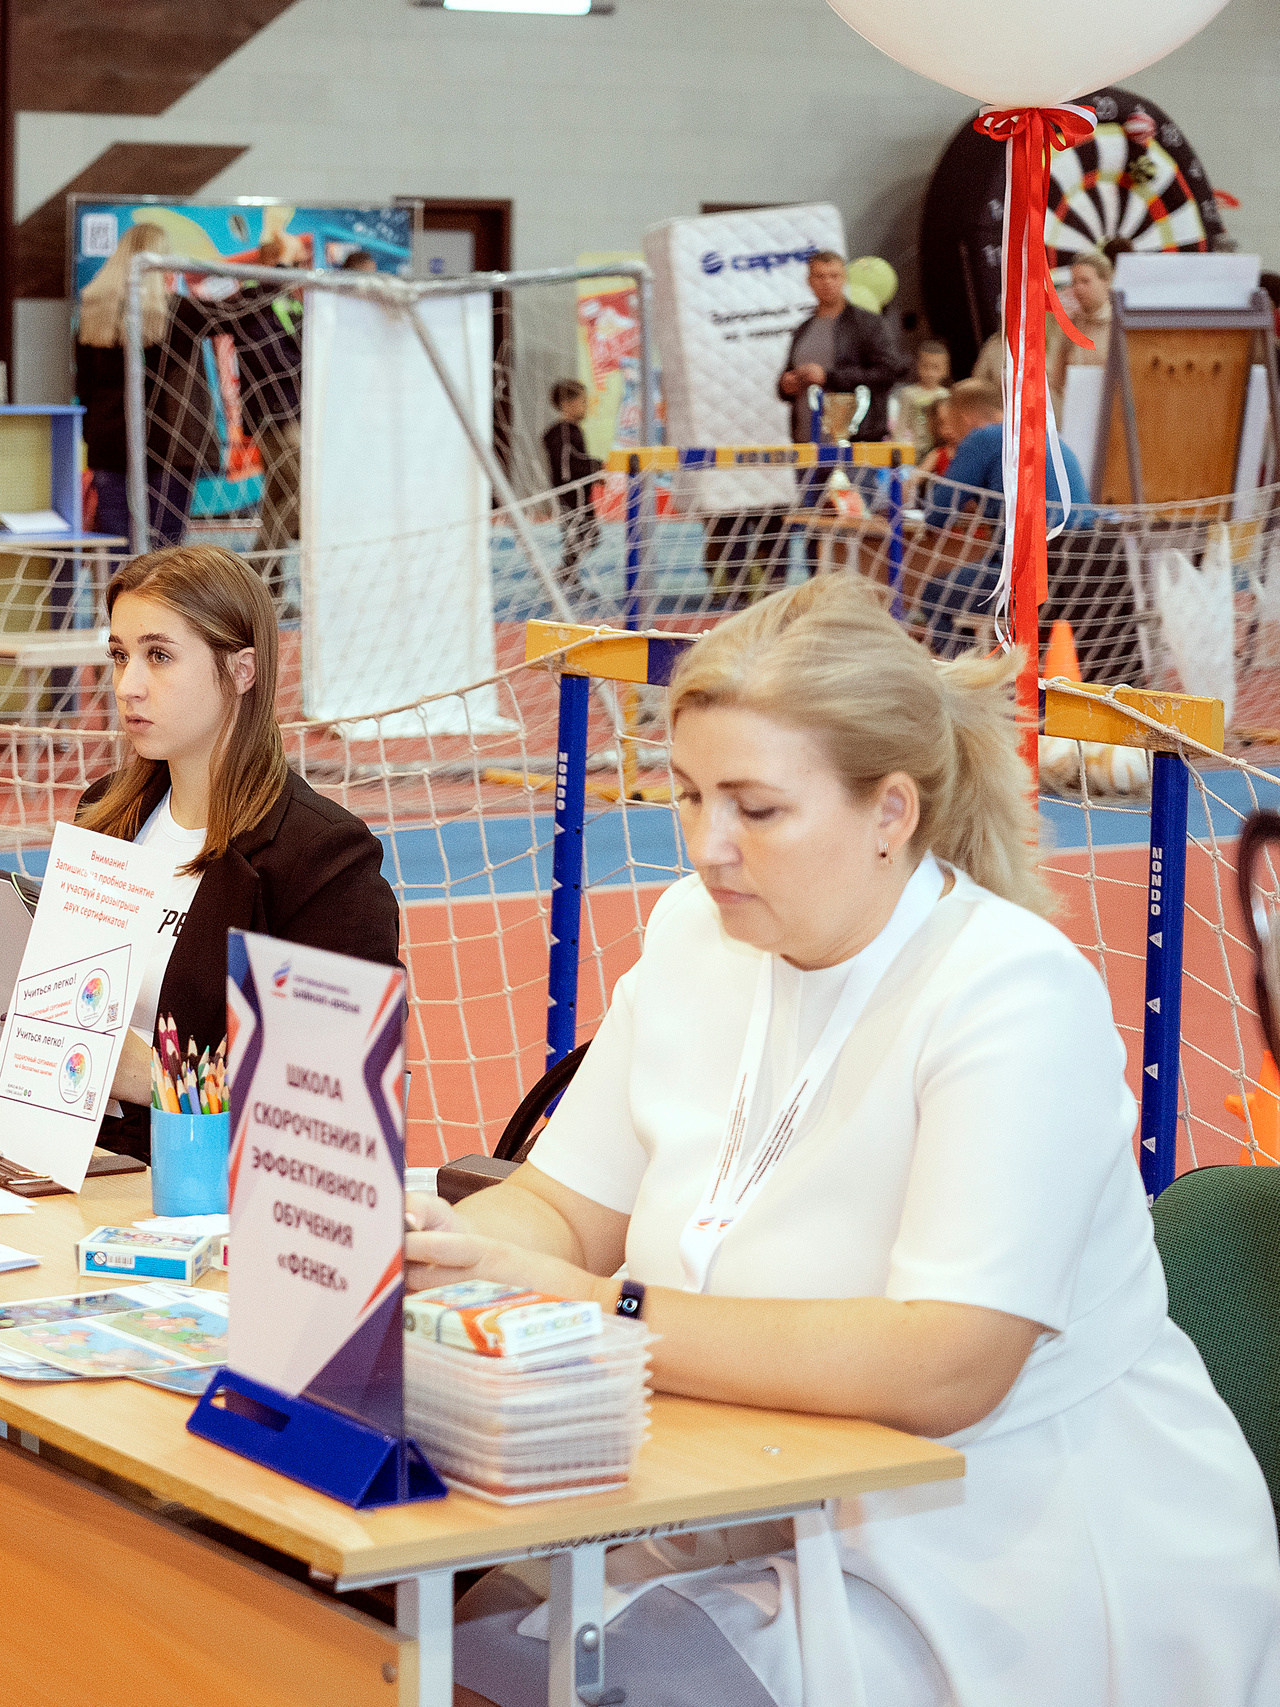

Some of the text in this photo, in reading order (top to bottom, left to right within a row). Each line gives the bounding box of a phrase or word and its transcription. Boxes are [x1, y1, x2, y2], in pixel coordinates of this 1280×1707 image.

[556, 751, 569, 811] MONDO
[55, 858, 88, 878] Запишись
[98, 873, 128, 890] пробное
[127, 883, 155, 899] занятие
[90, 850, 129, 871] Внимание!
[1150, 846, 1163, 916] MONDO
[60, 881, 140, 914] и участвуй в розыгрыше
[63, 901, 129, 930] двух сертификатов!
[23, 973, 77, 1000] Учиться легко!
[16, 1027, 65, 1048] Учиться легко!
[286, 1063, 343, 1103] ШКОЛА
[253, 1101, 377, 1161] СКОРОЧТЕНИЯ И
[251, 1145, 378, 1209] ЭФФЕКТИВНОГО
[273, 1200, 354, 1248] ОБУЧЕНИЯ
[277, 1251, 349, 1292] «ФЕНЕК»
